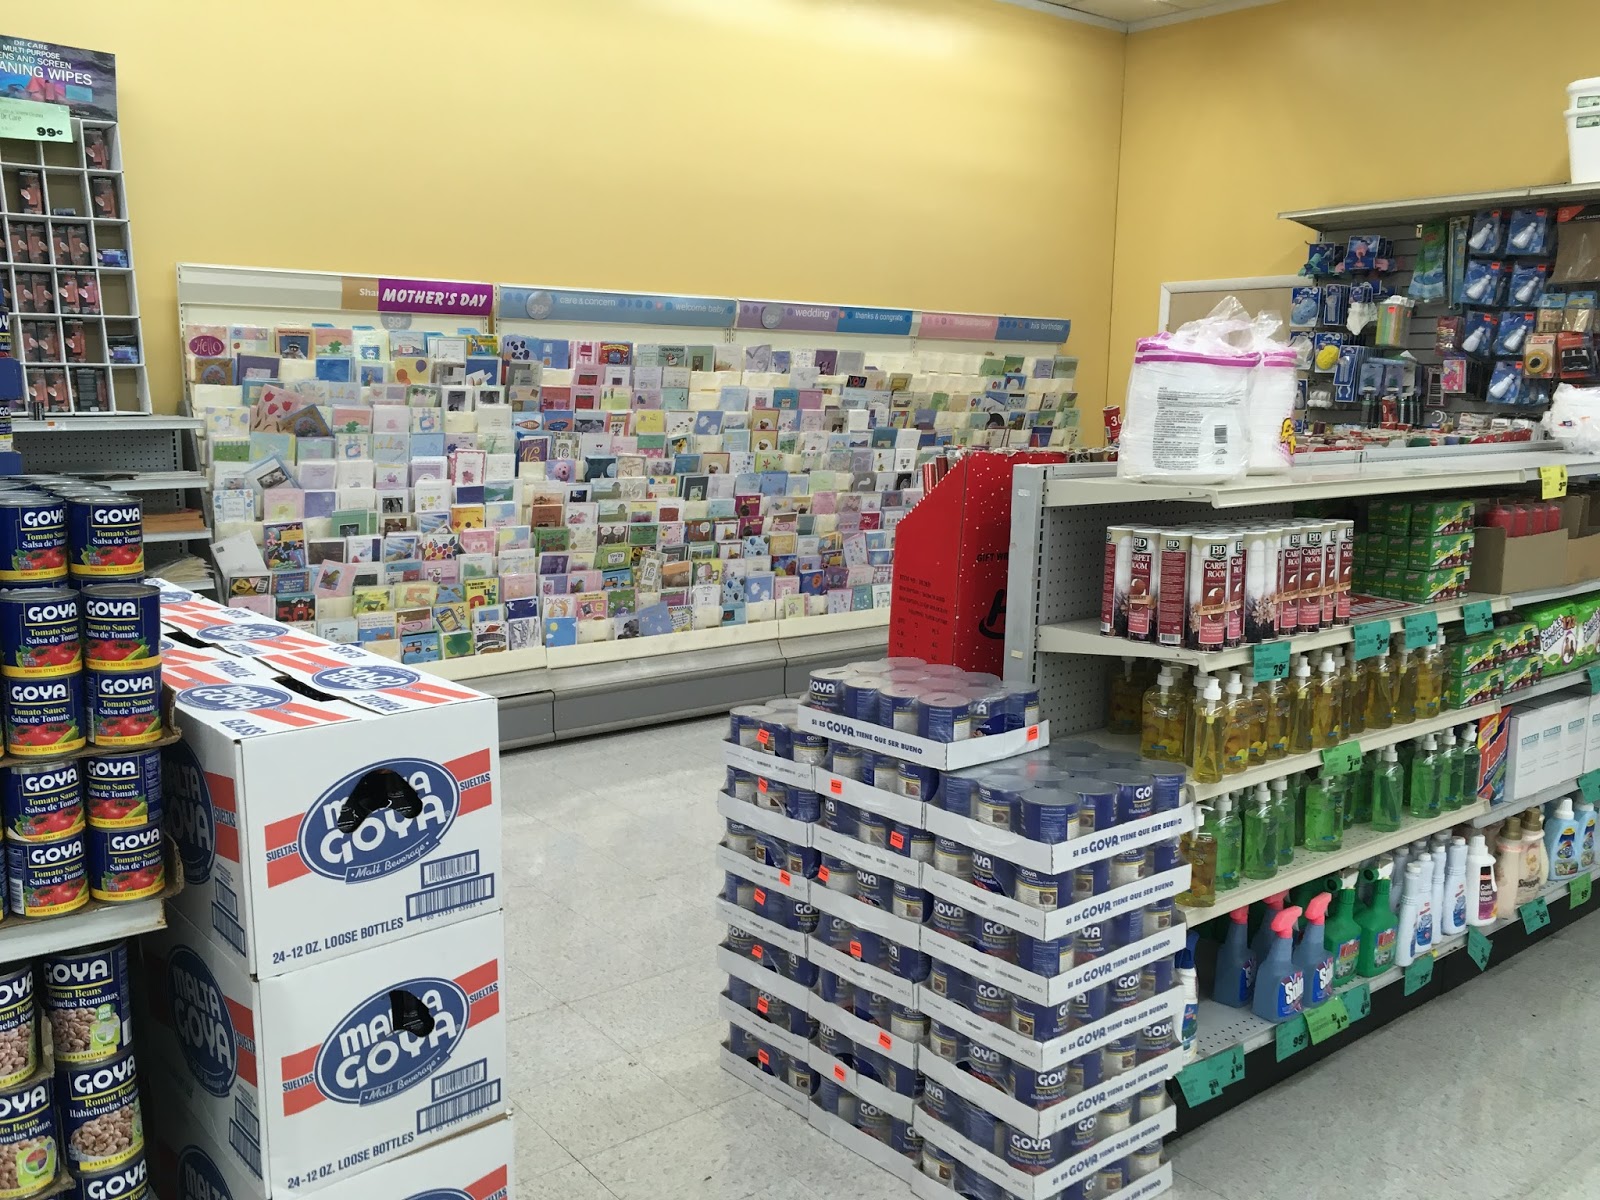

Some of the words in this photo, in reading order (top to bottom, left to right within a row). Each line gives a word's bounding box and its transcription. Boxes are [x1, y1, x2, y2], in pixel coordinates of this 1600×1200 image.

[3, 45, 25, 53] MULTI
[26, 49, 60, 60] PURPOSE
[27, 42, 48, 50] CARE
[16, 55, 35, 64] AND
[37, 57, 72, 70] SCREEN
[47, 69, 93, 86] WIPES
[382, 288, 456, 307] MOTHER'S
[459, 292, 487, 308] DAY
[559, 296, 577, 305] care
[585, 298, 616, 307] concern
[675, 302, 706, 312] welcome
[708, 303, 725, 315] baby
[795, 307, 830, 320] wedding
[855, 311, 874, 320] thanks
[879, 314, 903, 324] congrats
[1030, 321, 1040, 329] his
[1041, 323, 1063, 332] birthday
[94, 507, 140, 524] GOYA
[1134, 537, 1147, 545] BD
[1167, 540, 1179, 548] BD
[1309, 533, 1321, 542] BD
[976, 553, 995, 563] GIFT
[1211, 545, 1226, 555] BD
[1205, 561, 1227, 569] CARPE
[27, 602, 77, 622] GOYA
[86, 601, 136, 616] GOYA
[29, 628, 60, 637] Tomato
[211, 660, 256, 678] FRAGILE
[1273, 664, 1286, 676] 79¢
[11, 684, 67, 701] GOYA
[100, 676, 153, 694] GOYA
[99, 707, 118, 715] Salsa
[130, 704, 155, 714] Tomate
[103, 700, 131, 708] Tomato
[132, 698, 153, 706] Sauce
[11, 715, 29, 723] Salsa
[41, 714, 70, 723] Tomate
[220, 719, 266, 736] GLASS
[811, 718, 818, 726] SI
[827, 720, 854, 737] GOYA
[856, 731, 873, 741] TIENE
[874, 735, 887, 745] QUE
[888, 739, 900, 749] SER
[901, 743, 923, 755] BUENO
[25, 768, 78, 792] GOYA
[459, 773, 491, 791] SUELTAS
[25, 805, 46, 814] Salsa
[48, 804, 57, 812] de
[58, 797, 80, 810] Tomate
[28, 796, 58, 806] Tomato
[60, 790, 78, 800] Sauce
[320, 794, 446, 864] GOYA
[111, 828, 160, 850] GOYA
[1073, 849, 1079, 857] SI
[1081, 847, 1088, 855] ES
[1089, 835, 1118, 853] GOYA
[1120, 831, 1137, 842] TIENE
[1138, 829, 1150, 837] QUE
[1151, 825, 1162, 833] SER
[31, 841, 82, 864] GOYA
[113, 855, 142, 864] Tomato
[143, 850, 160, 859] Sauce
[266, 843, 298, 861] SUELTAS
[355, 863, 381, 878] Malt
[384, 842, 425, 870] Beverage
[32, 869, 63, 878] Tomato
[64, 863, 83, 872] Sauce
[110, 863, 129, 872] Salsa
[131, 862, 140, 870] de
[142, 855, 162, 866] Tomate
[30, 878, 51, 886] Salsa
[52, 875, 62, 883] de
[64, 869, 85, 881] Tomate
[1074, 914, 1081, 922] ES
[1082, 901, 1111, 920] GOYA
[1112, 896, 1128, 907] TIENE
[1129, 892, 1142, 901] QUE
[1143, 888, 1154, 897] SER
[1155, 881, 1174, 892] BUENO
[273, 945, 304, 965] 24-12
[305, 940, 322, 956] OZ.
[324, 930, 358, 949] LOOSE
[360, 917, 404, 938] BOTTLES
[1067, 981, 1074, 989] SI
[1075, 977, 1082, 985] ES
[1083, 963, 1112, 982] GOYA
[1113, 957, 1128, 969] TIENE
[1129, 954, 1141, 962] QUE
[1141, 948, 1152, 956] SER
[1153, 940, 1171, 952] BUENO
[79, 992, 118, 1007] Romanas
[172, 964, 223, 1022] MALTA
[469, 983, 499, 1004] SUELTAS
[174, 998, 232, 1071] GOYA
[335, 1011, 457, 1089] GOYA
[74, 1055, 136, 1094] GOYA
[282, 1073, 314, 1092] SUELTAS
[369, 1086, 394, 1101] Malt
[397, 1059, 437, 1089] Beverage
[85, 1094, 117, 1107] Roman
[69, 1102, 121, 1118] Habichuelas
[13, 1119, 39, 1131] Beans
[29, 1120, 52, 1136] Pintas
[287, 1171, 318, 1189] 24-12
[319, 1163, 336, 1179] OZ.
[338, 1149, 371, 1171] LOOSE
[372, 1131, 414, 1156] BOTTLES
[87, 1159, 147, 1200] GOYA
